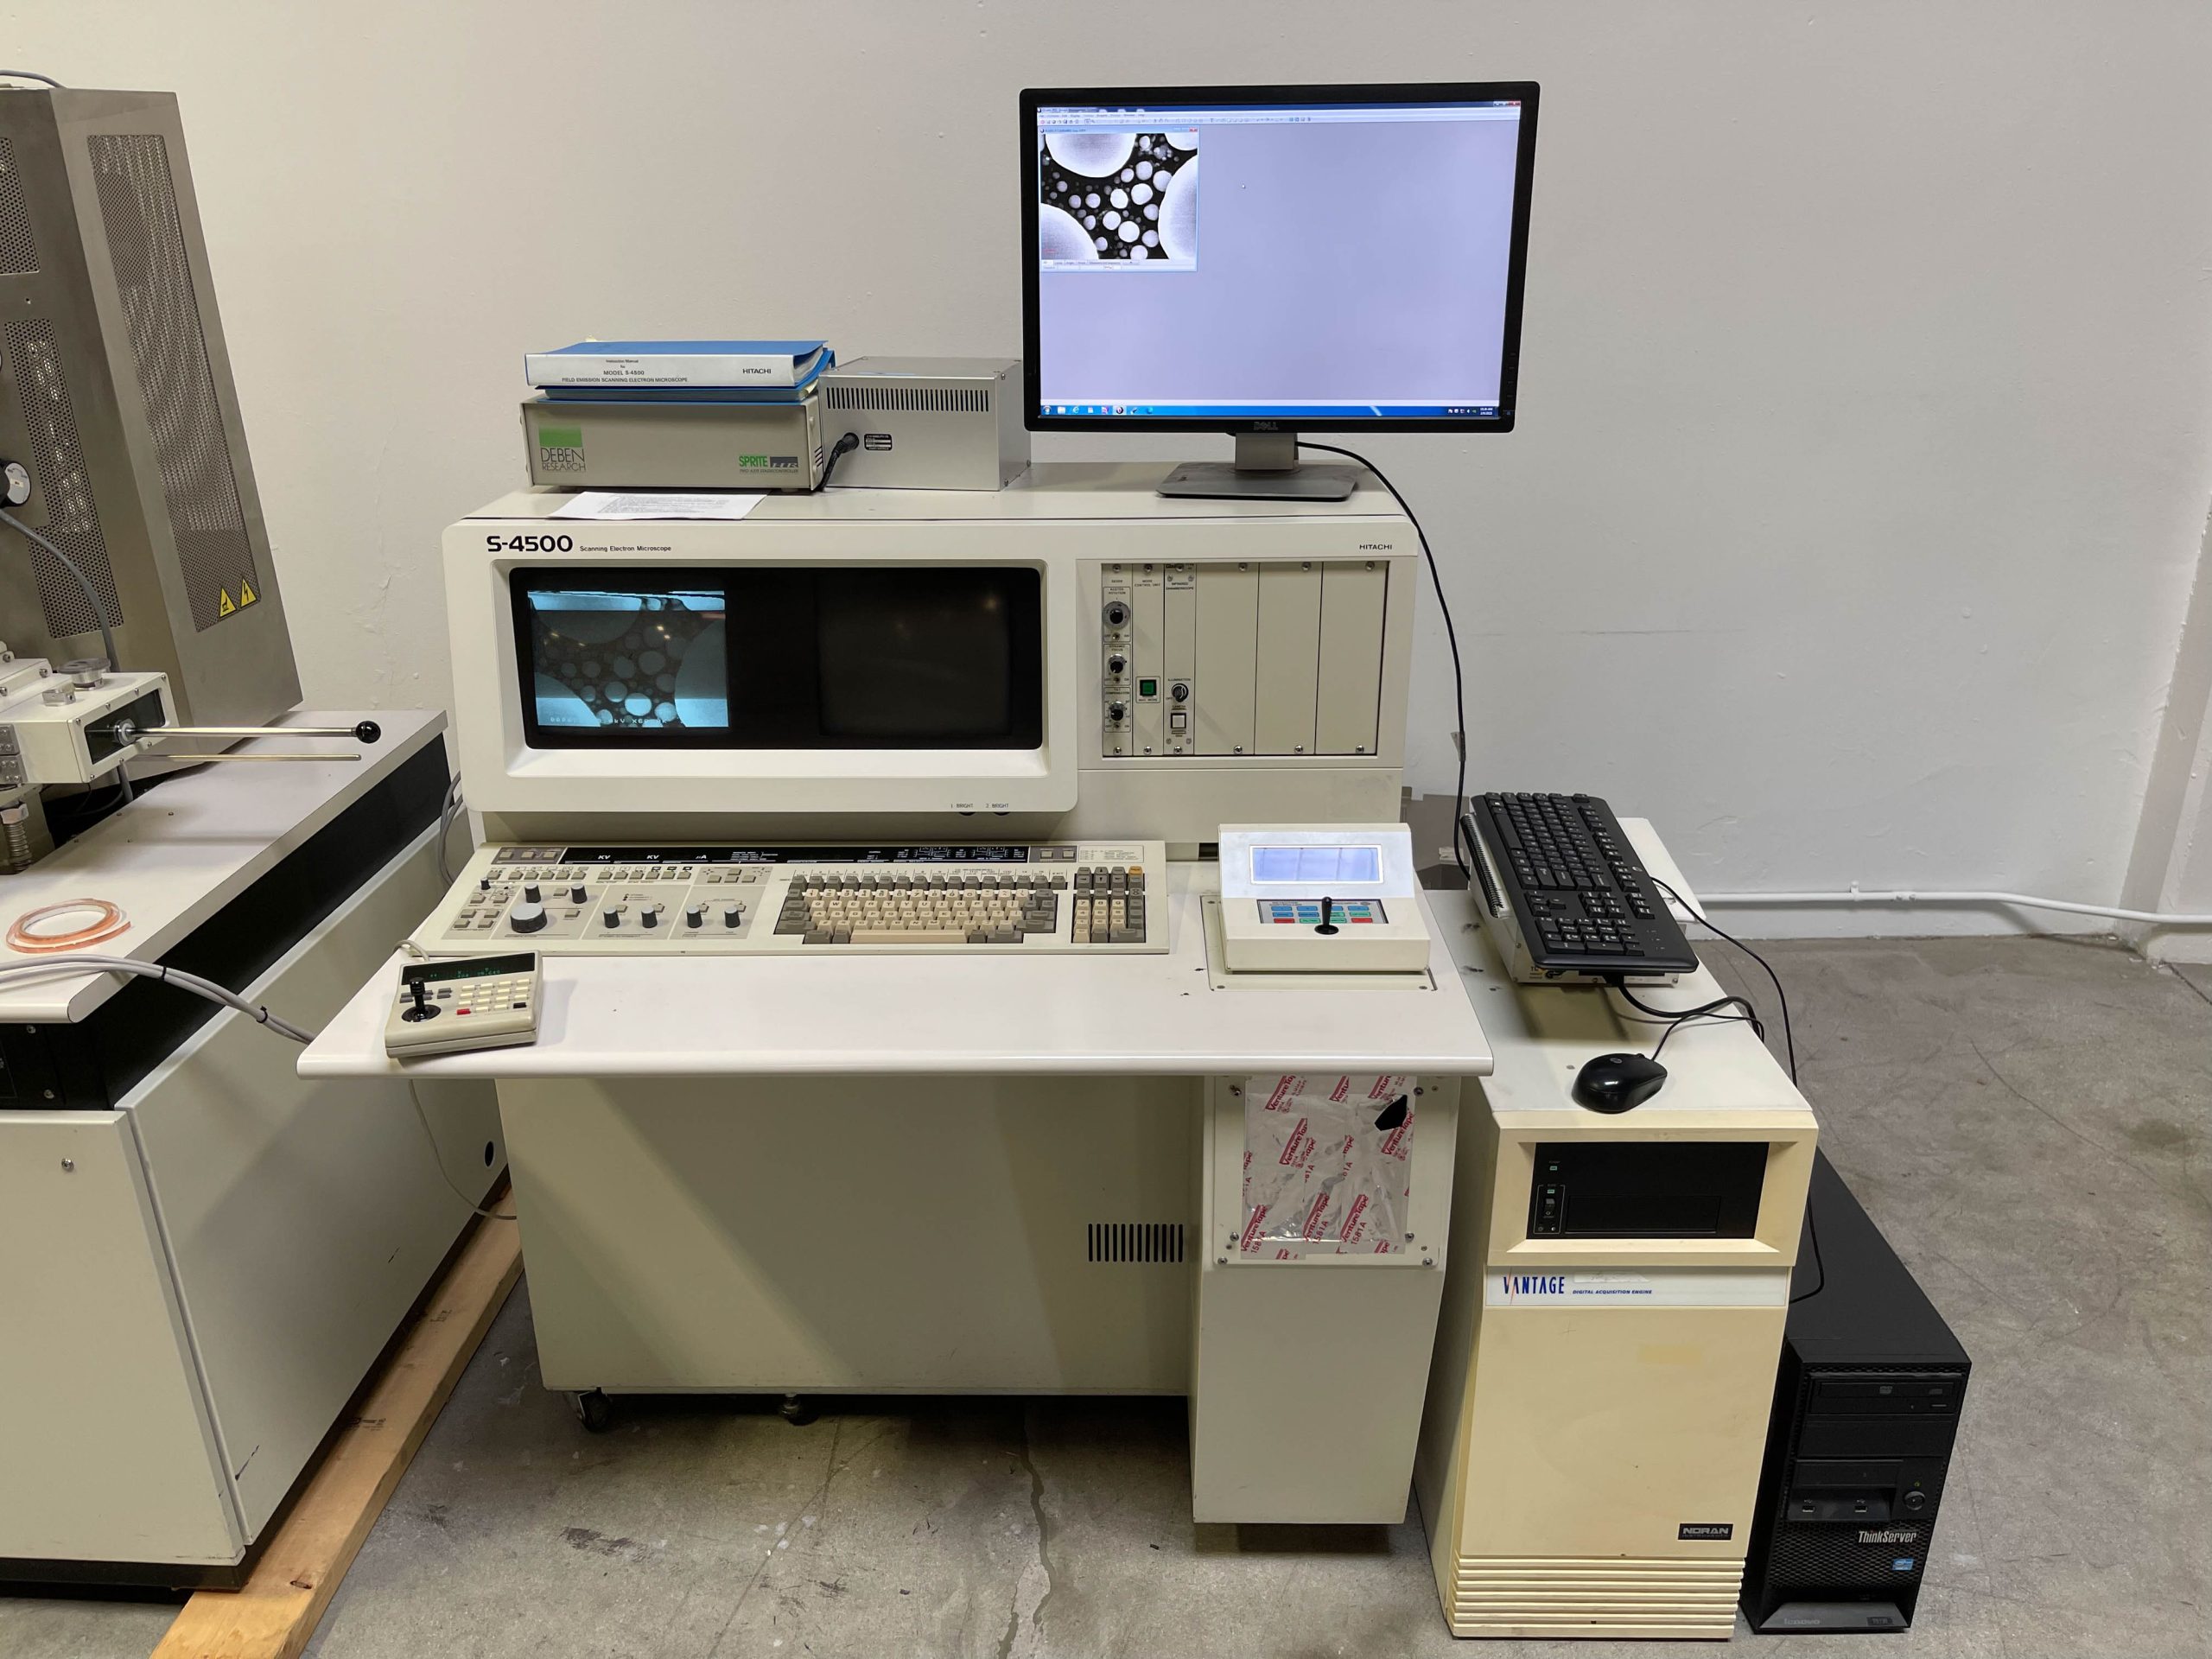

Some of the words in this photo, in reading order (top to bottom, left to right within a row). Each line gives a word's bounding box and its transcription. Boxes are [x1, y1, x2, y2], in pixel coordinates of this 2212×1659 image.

[1254, 421, 1279, 430] DELL
[540, 448, 585, 462] DEBEN
[739, 455, 768, 467] SPRITE
[542, 462, 586, 472] RESEARCH
[486, 535, 573, 552] S-4500
[1340, 1195, 1369, 1243] VentureTape
[1313, 1220, 1329, 1245] 1581A
[1351, 1221, 1367, 1245] 1581A
[1503, 1276, 1566, 1294] VANTAGE
[1858, 1530, 1917, 1543] ThinkServer
